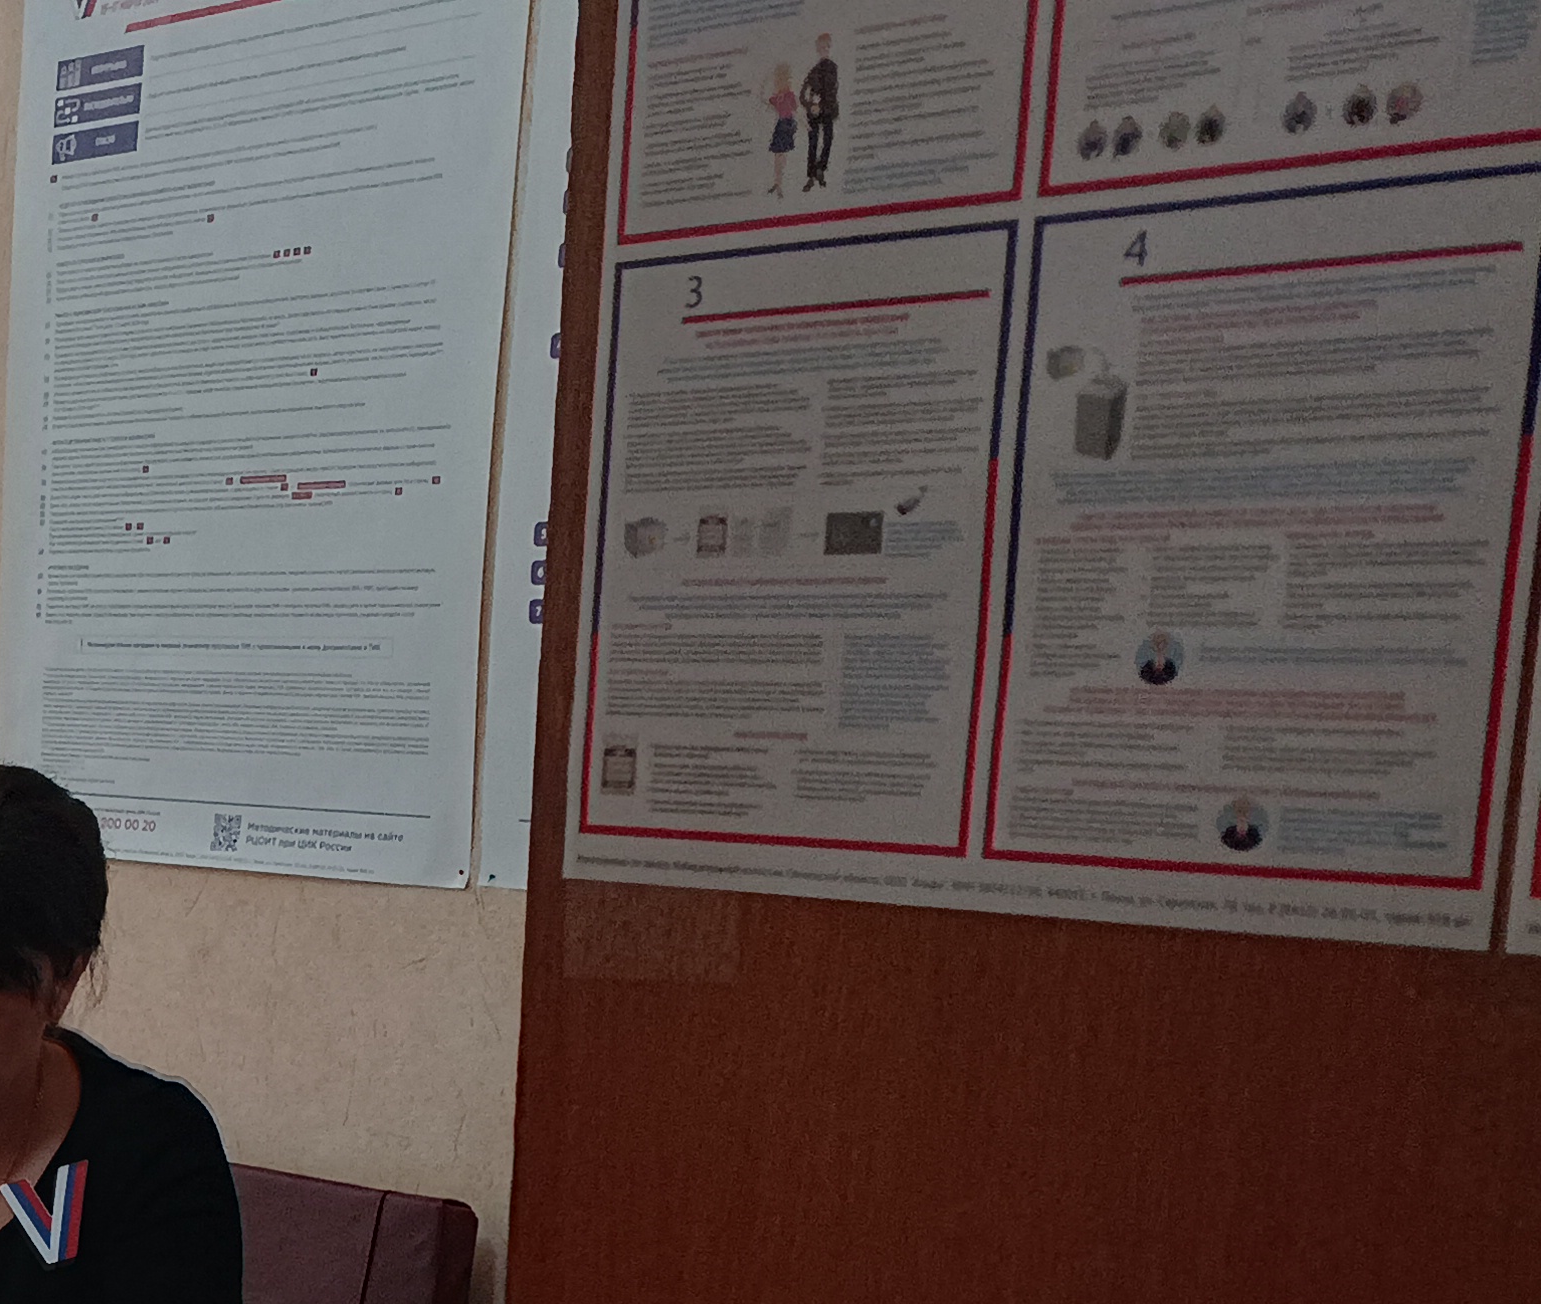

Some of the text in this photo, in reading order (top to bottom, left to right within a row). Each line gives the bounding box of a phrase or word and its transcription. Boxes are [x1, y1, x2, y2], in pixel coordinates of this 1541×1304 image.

[1123, 230, 1148, 267] 4
[685, 275, 703, 309] 3
[124, 818, 140, 832] 00
[141, 819, 157, 833] 20
